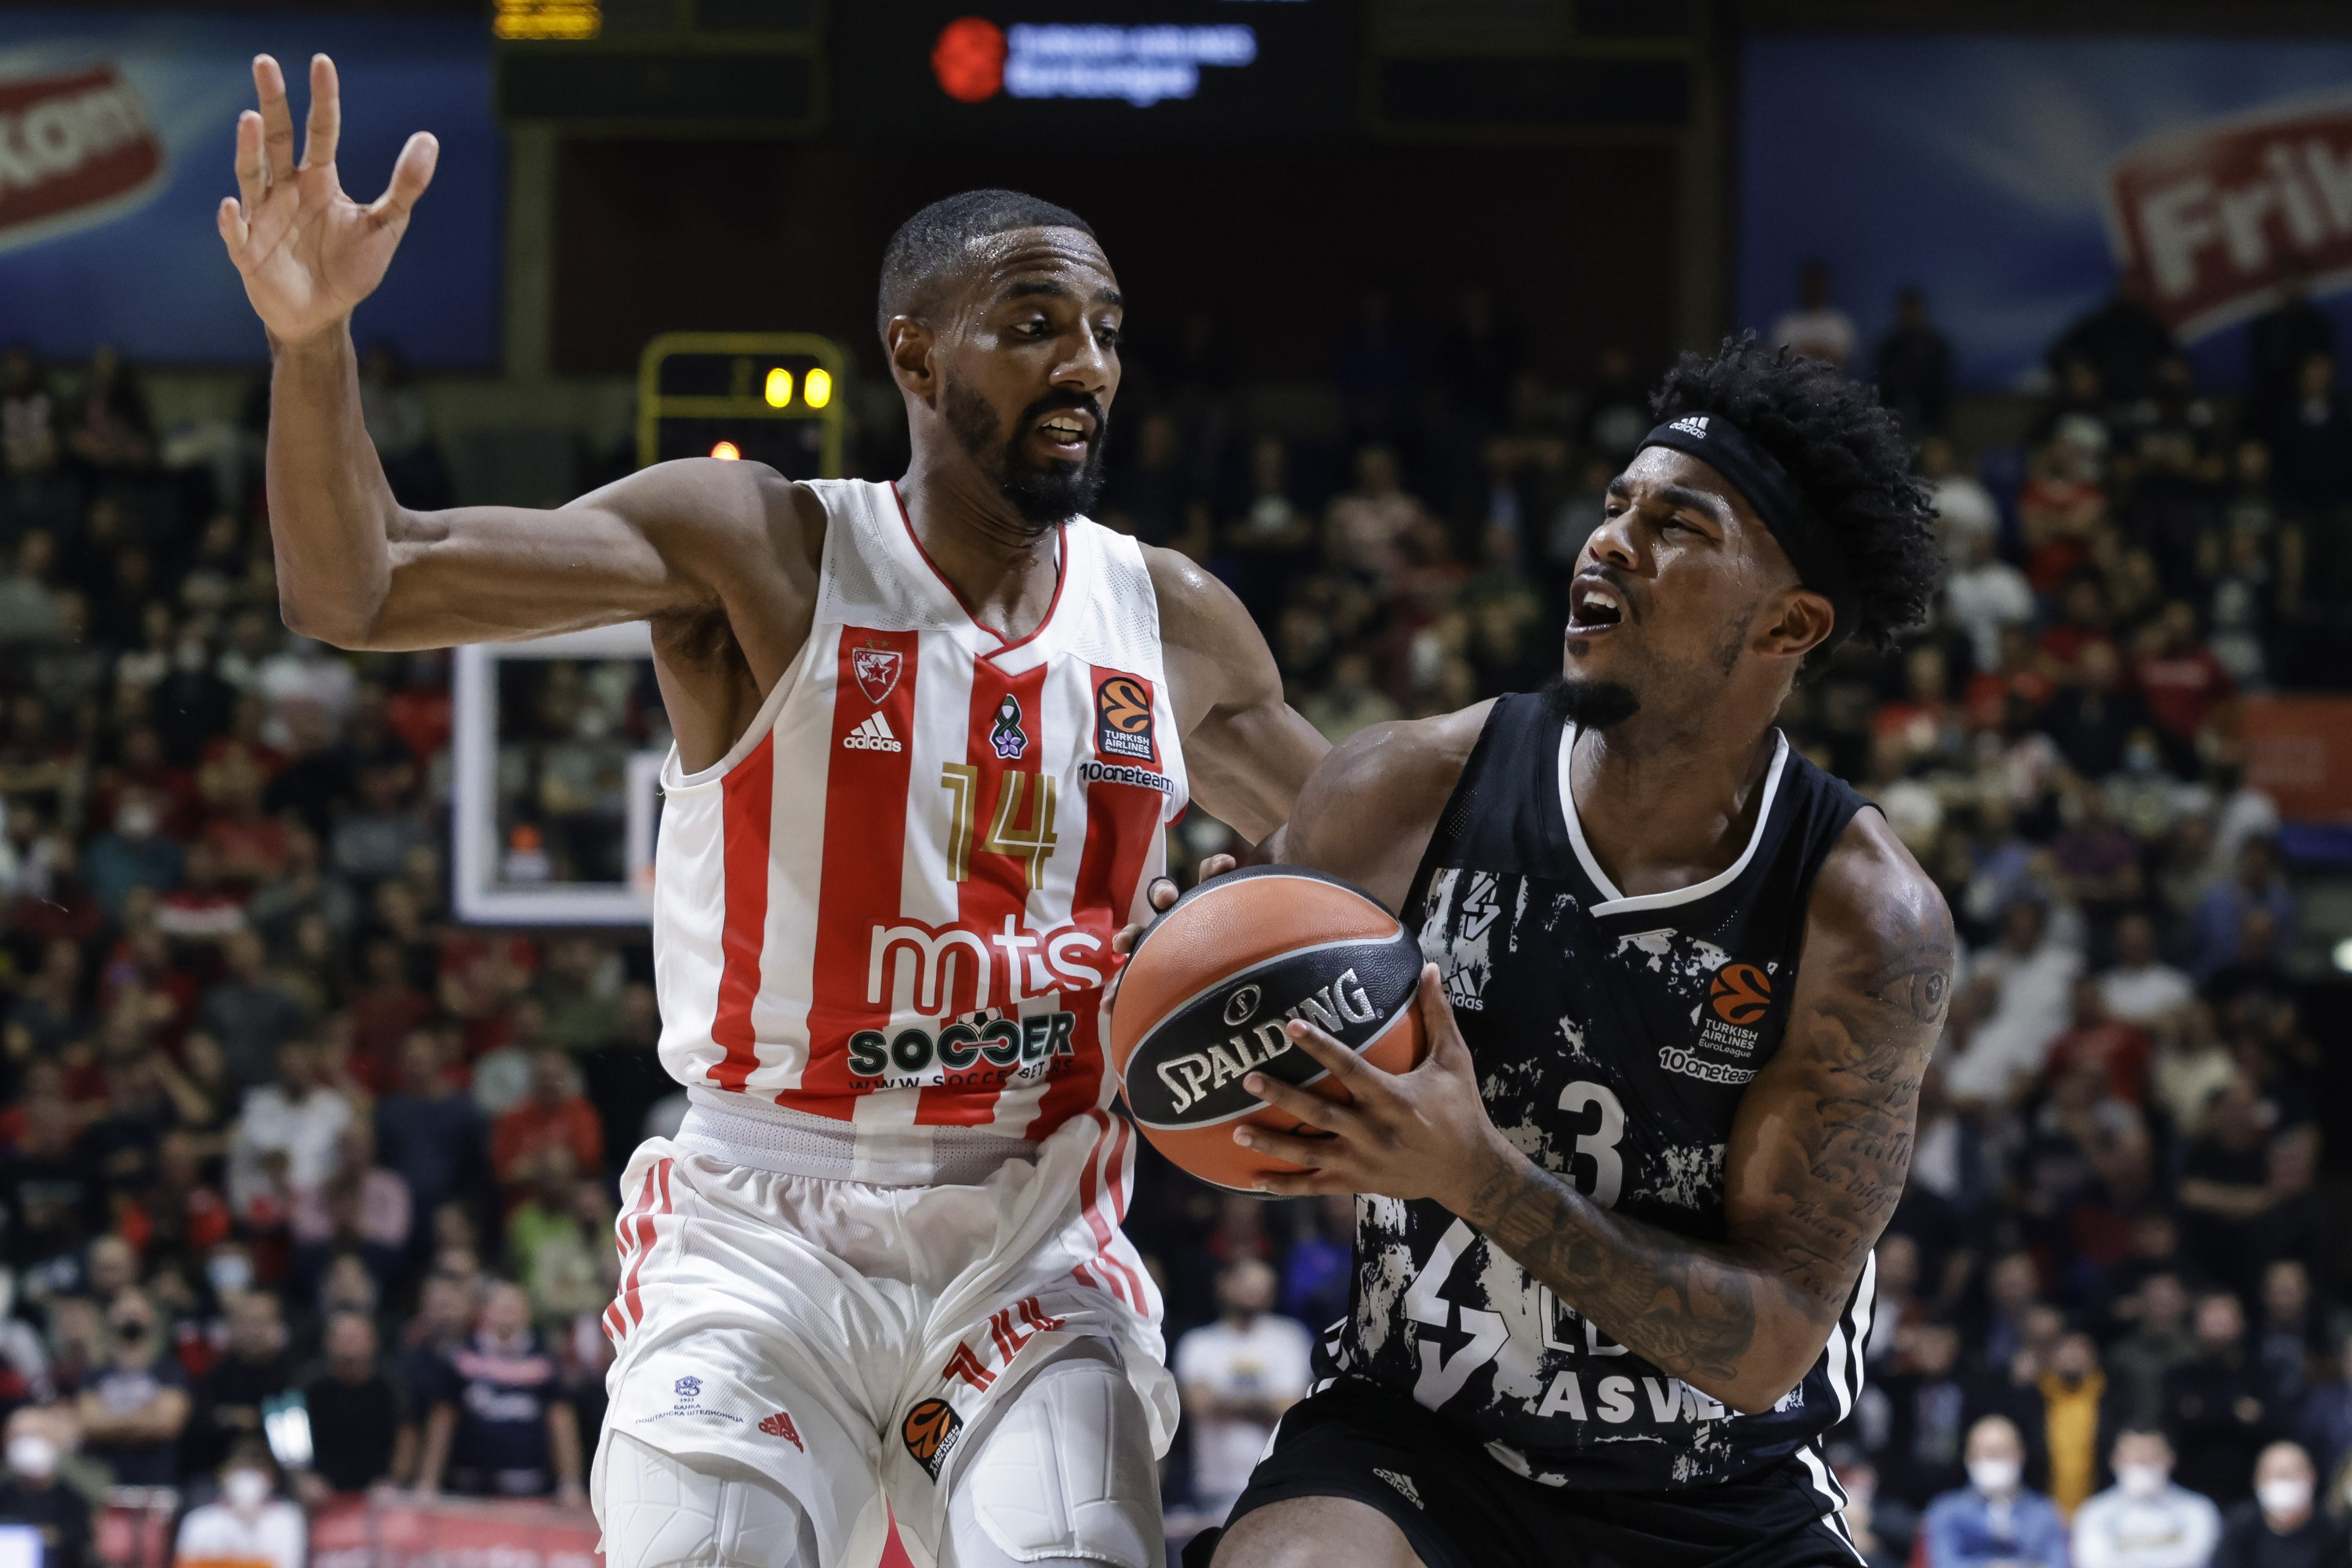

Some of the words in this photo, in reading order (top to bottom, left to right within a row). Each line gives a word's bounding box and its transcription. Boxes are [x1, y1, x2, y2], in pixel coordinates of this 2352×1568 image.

[1669, 422, 1707, 439] adidas
[844, 735, 902, 753] adidas
[1105, 730, 1150, 746] TURKISH
[1105, 738, 1150, 754] AIRLINES
[942, 762, 1058, 891] 14
[867, 913, 1102, 1011] mts
[1700, 1029, 1755, 1050] AIRLINES
[1705, 1018, 1759, 1041] TURKISH
[848, 1011, 1076, 1077] SOCCER
[1698, 1038, 1752, 1058] EuroLeague
[1558, 1080, 1625, 1209] 3
[635, 1410, 685, 1424] ПОШТАНСКА
[687, 1410, 744, 1423] ШТЕДИОНИЦА
[758, 1421, 804, 1454] adidas
[928, 1424, 960, 1470] TURKISH
[1373, 1468, 1425, 1511] adidas
